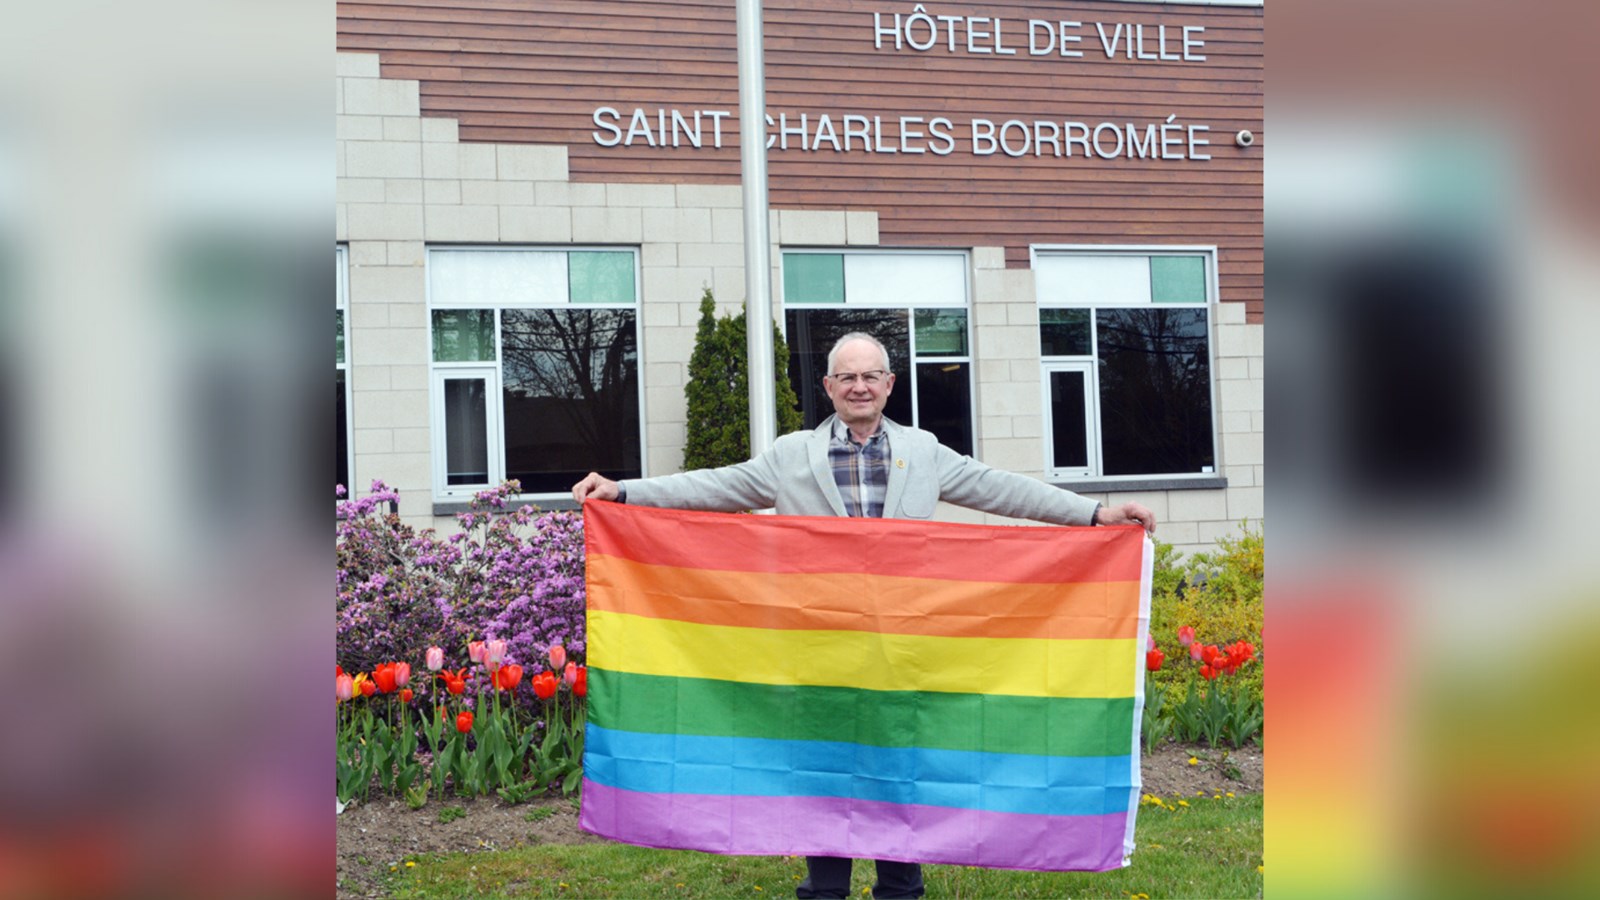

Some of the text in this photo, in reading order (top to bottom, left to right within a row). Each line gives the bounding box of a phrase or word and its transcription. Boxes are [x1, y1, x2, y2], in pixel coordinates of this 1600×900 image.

[873, 4, 1207, 62] HÔTEL DE VILLE
[592, 107, 731, 148] SAINT
[971, 114, 1212, 161] BORROMÉE
